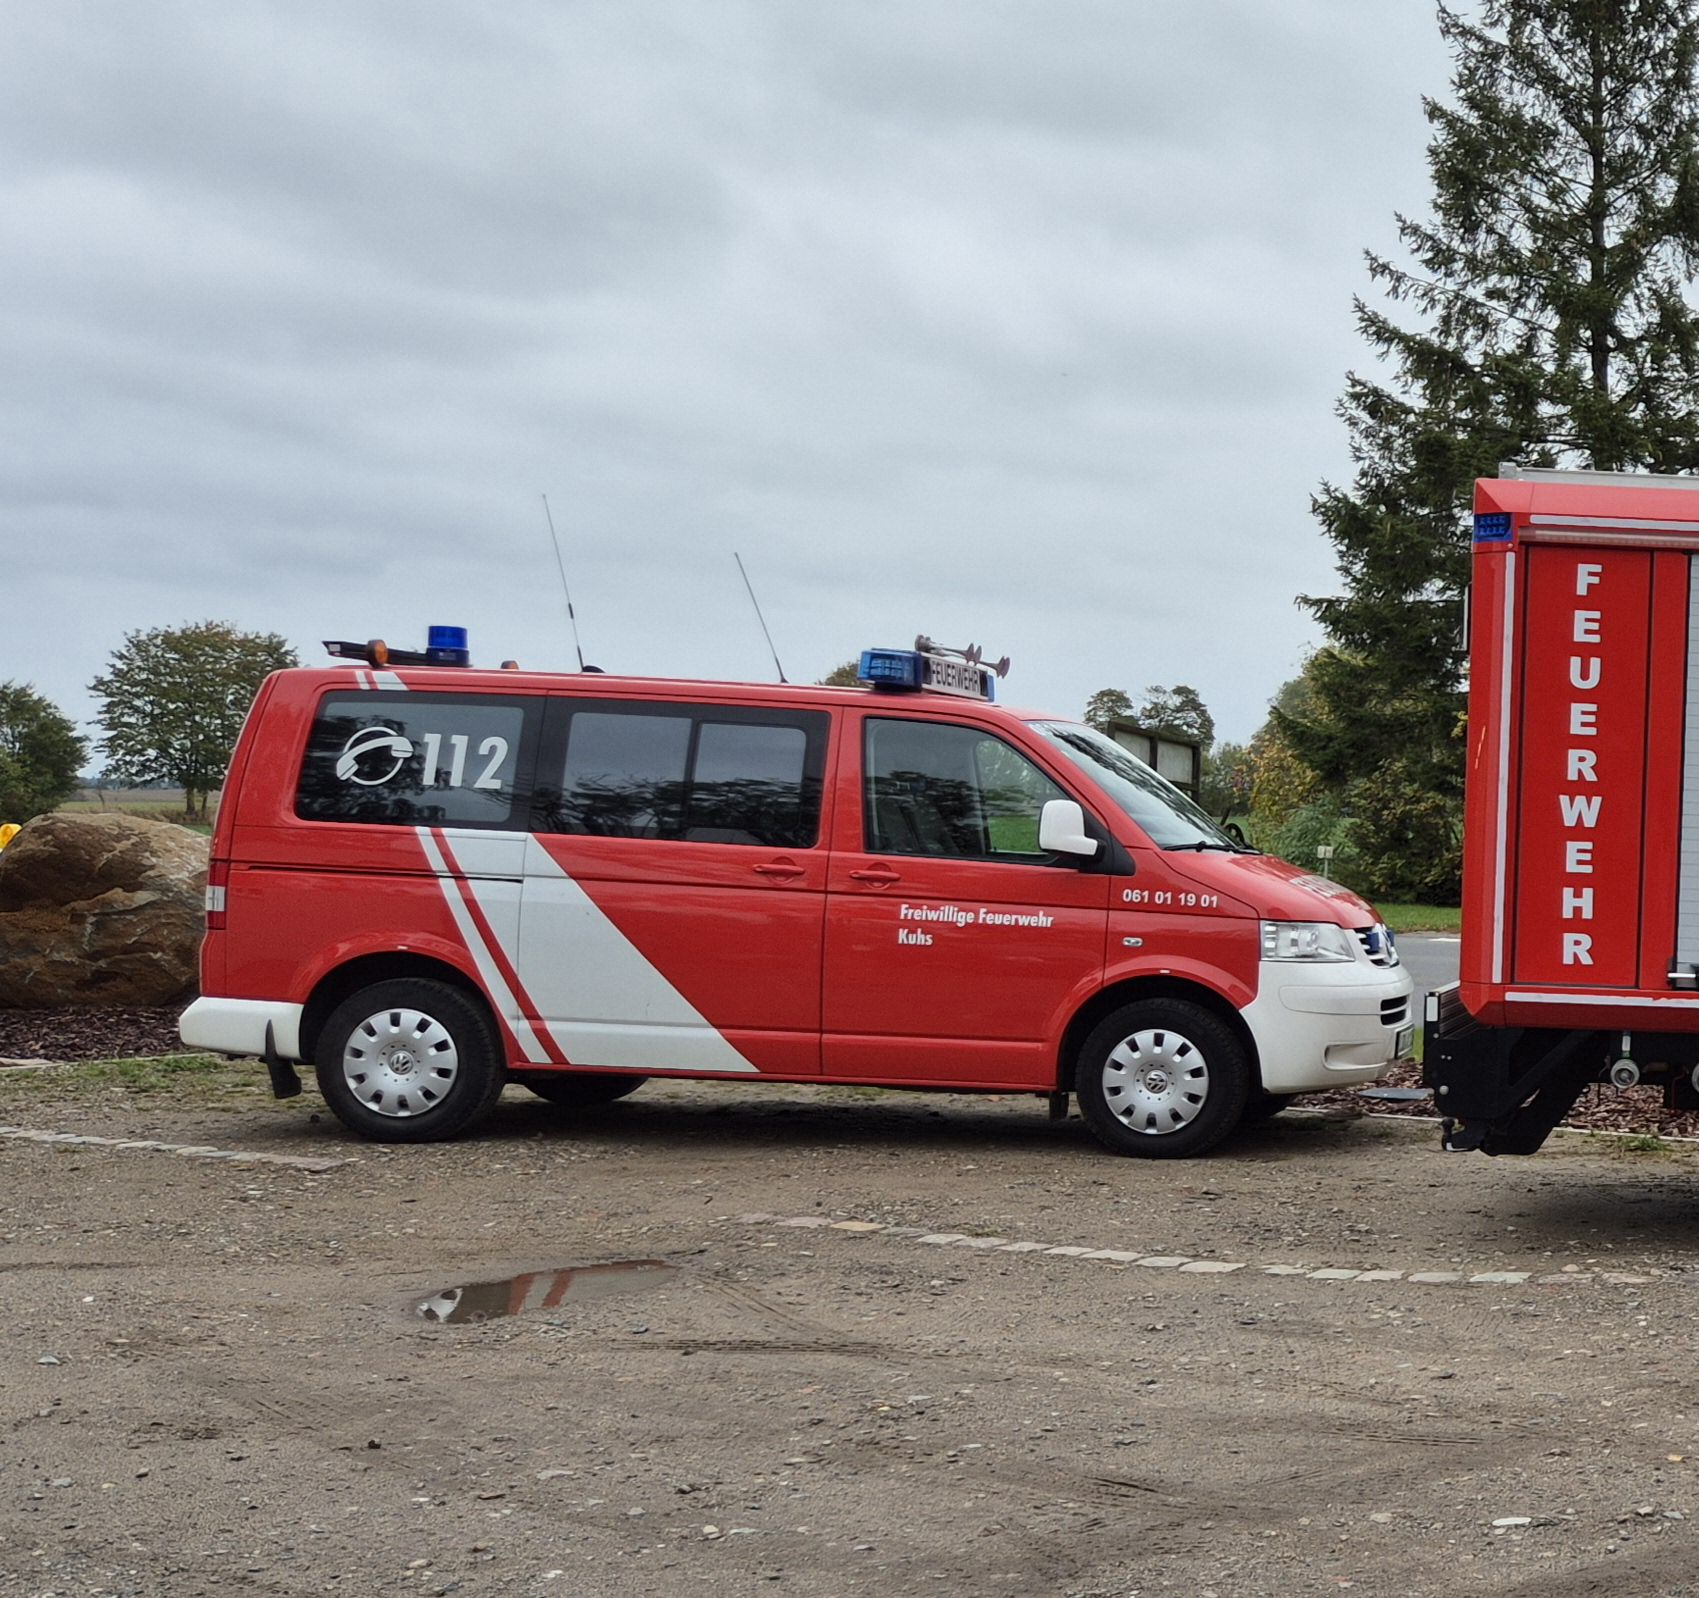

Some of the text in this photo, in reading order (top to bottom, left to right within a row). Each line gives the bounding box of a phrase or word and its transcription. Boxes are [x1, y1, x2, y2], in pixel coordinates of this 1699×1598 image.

[931, 660, 980, 692] FEUERWEHR
[422, 733, 508, 789] 112
[1559, 563, 1603, 965] FEUERWEHR
[1122, 889, 1218, 908] 061 01 19 01
[900, 903, 1054, 927] Freiwillige Feuerwehr
[898, 928, 933, 945] Kuhs
